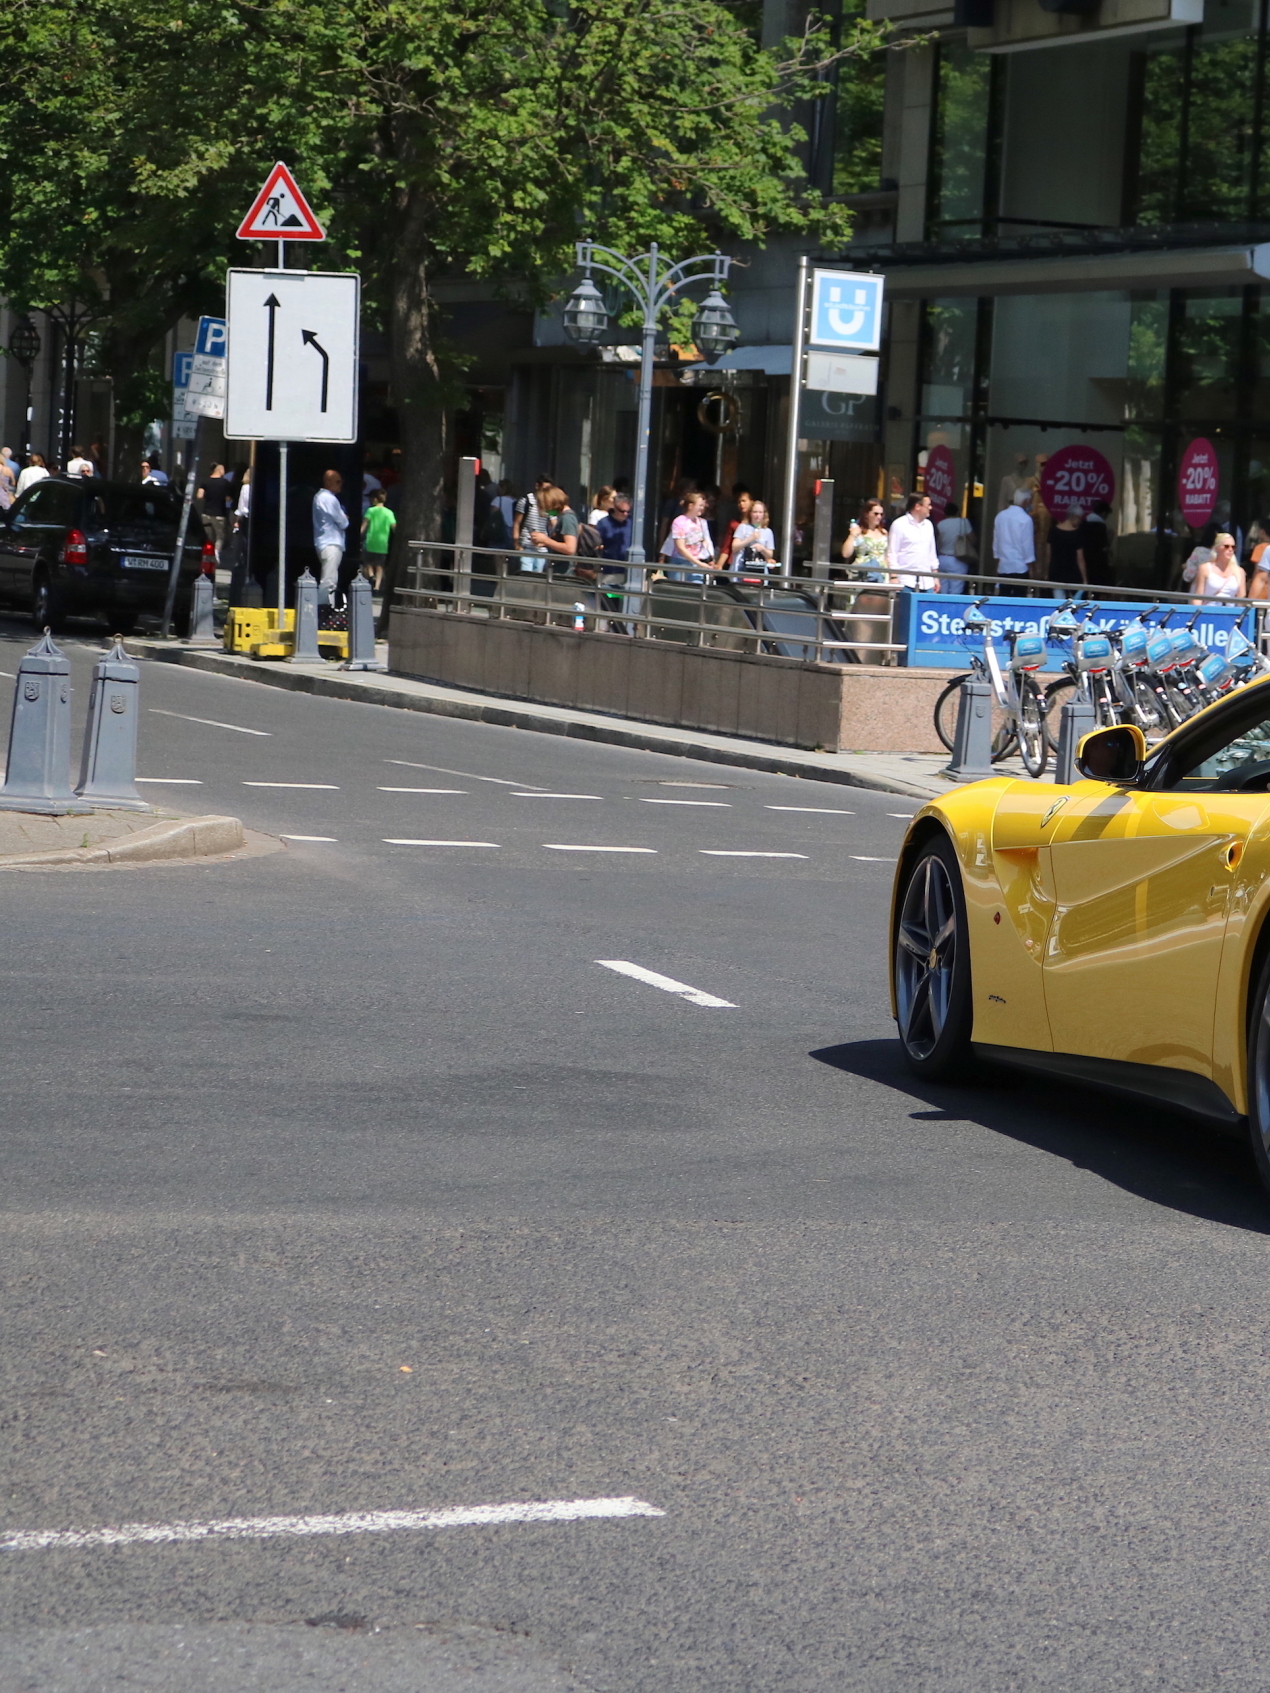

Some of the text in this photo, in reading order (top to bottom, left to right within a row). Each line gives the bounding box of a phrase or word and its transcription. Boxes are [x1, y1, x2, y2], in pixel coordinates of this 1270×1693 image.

[205, 323, 226, 352] P
[1064, 459, 1094, 470] Jetzt
[1192, 453, 1208, 463] Jetzt
[1047, 471, 1109, 494] -20%
[1182, 467, 1215, 490] -20%
[1185, 494, 1211, 504] RABATT
